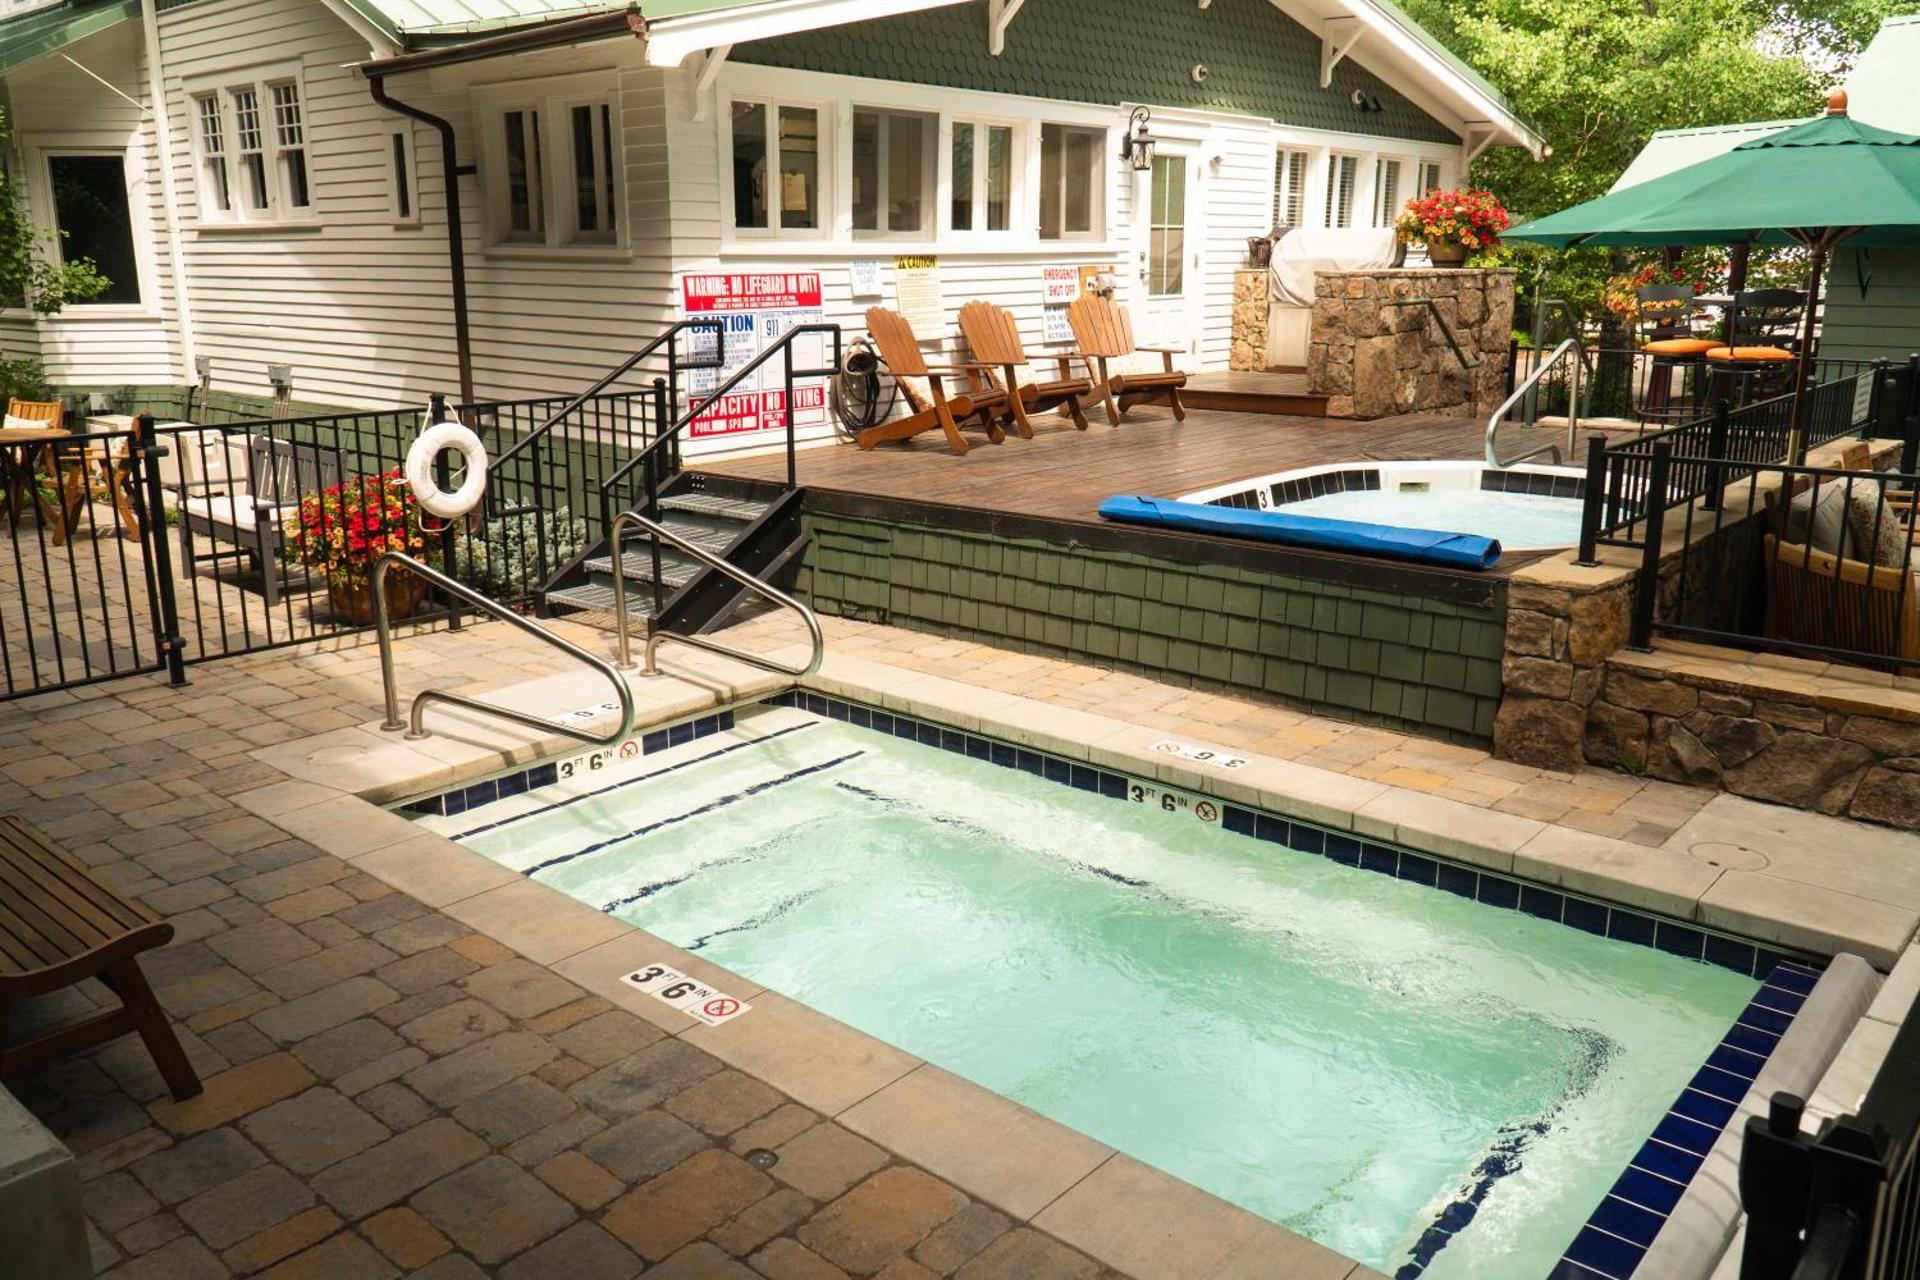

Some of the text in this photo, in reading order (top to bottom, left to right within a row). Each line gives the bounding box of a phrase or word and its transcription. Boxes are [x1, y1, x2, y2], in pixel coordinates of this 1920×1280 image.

[686, 274, 818, 297] WARNING: NO LIFEGUARD ON DUTY
[1043, 268, 1077, 280] EMERGENCY
[1049, 284, 1076, 296] SHUT OFF
[691, 314, 754, 334] CAUTION
[766, 319, 779, 336] 911
[766, 388, 820, 411] NO IVING
[561, 762, 574, 778] 3
[590, 753, 603, 770] 6
[1131, 785, 1145, 803] 3
[1161, 793, 1176, 811] 6
[630, 967, 665, 983] 3
[661, 982, 697, 999] 6
